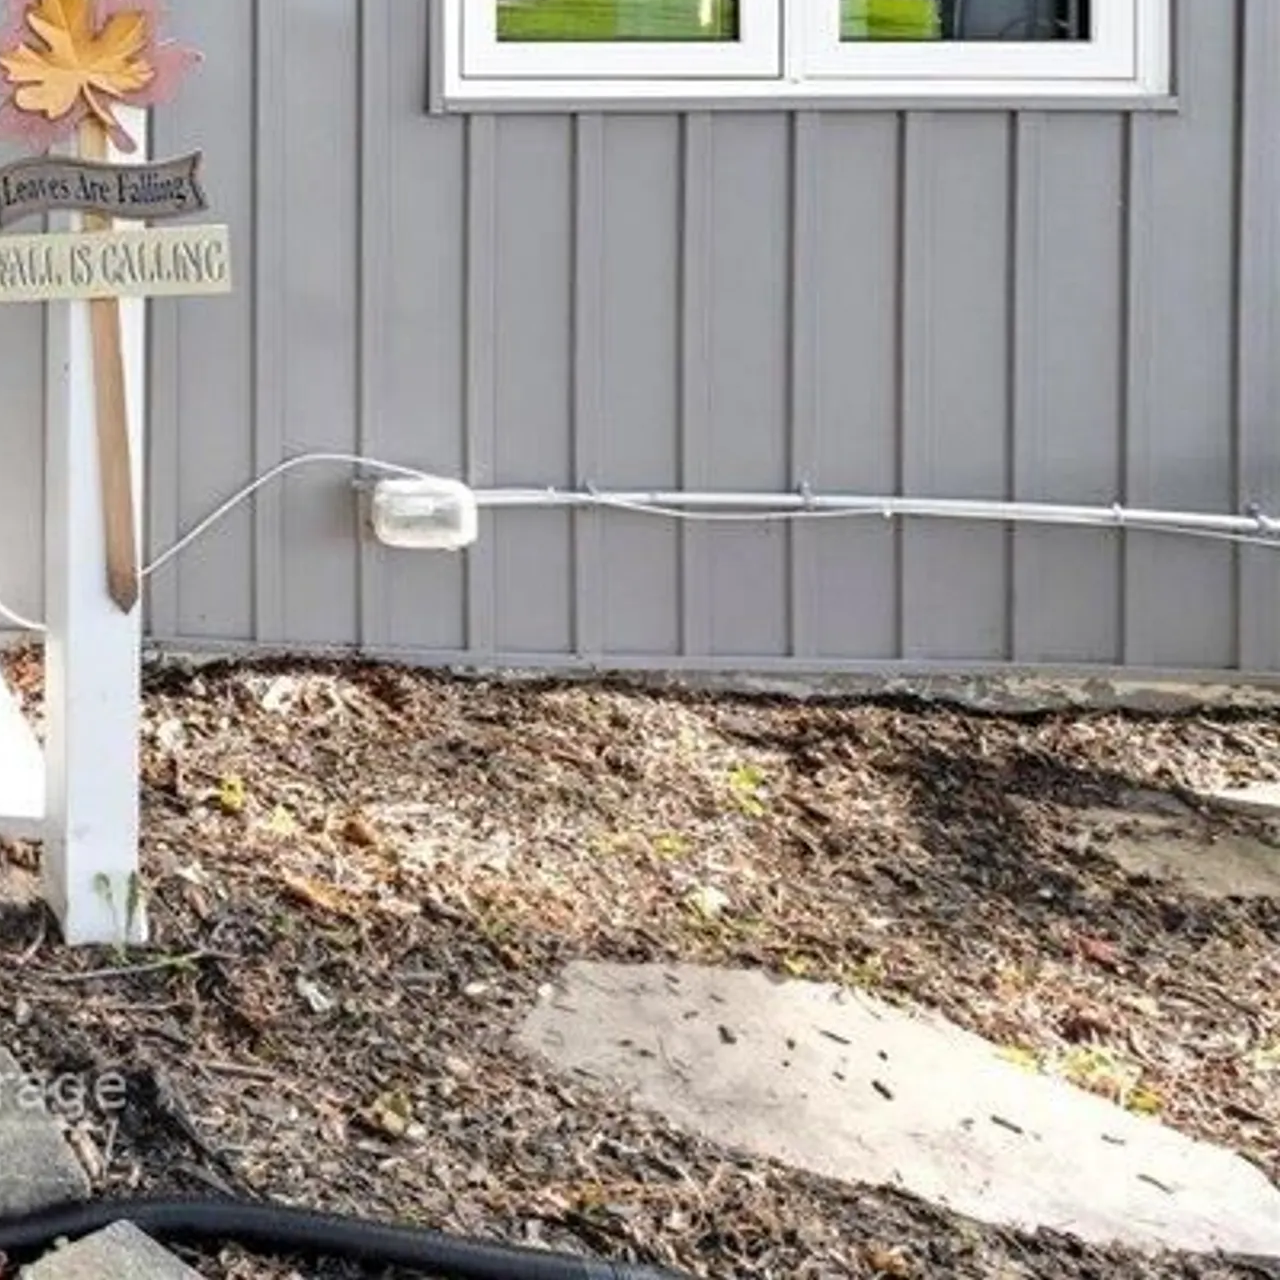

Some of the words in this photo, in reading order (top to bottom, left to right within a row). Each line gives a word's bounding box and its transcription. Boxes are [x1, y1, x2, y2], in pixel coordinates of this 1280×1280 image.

[2, 175, 69, 207] Leaves
[74, 172, 112, 204] Are
[117, 170, 188, 208] Falling
[70, 242, 93, 287] IS
[101, 239, 227, 286] CALLING
